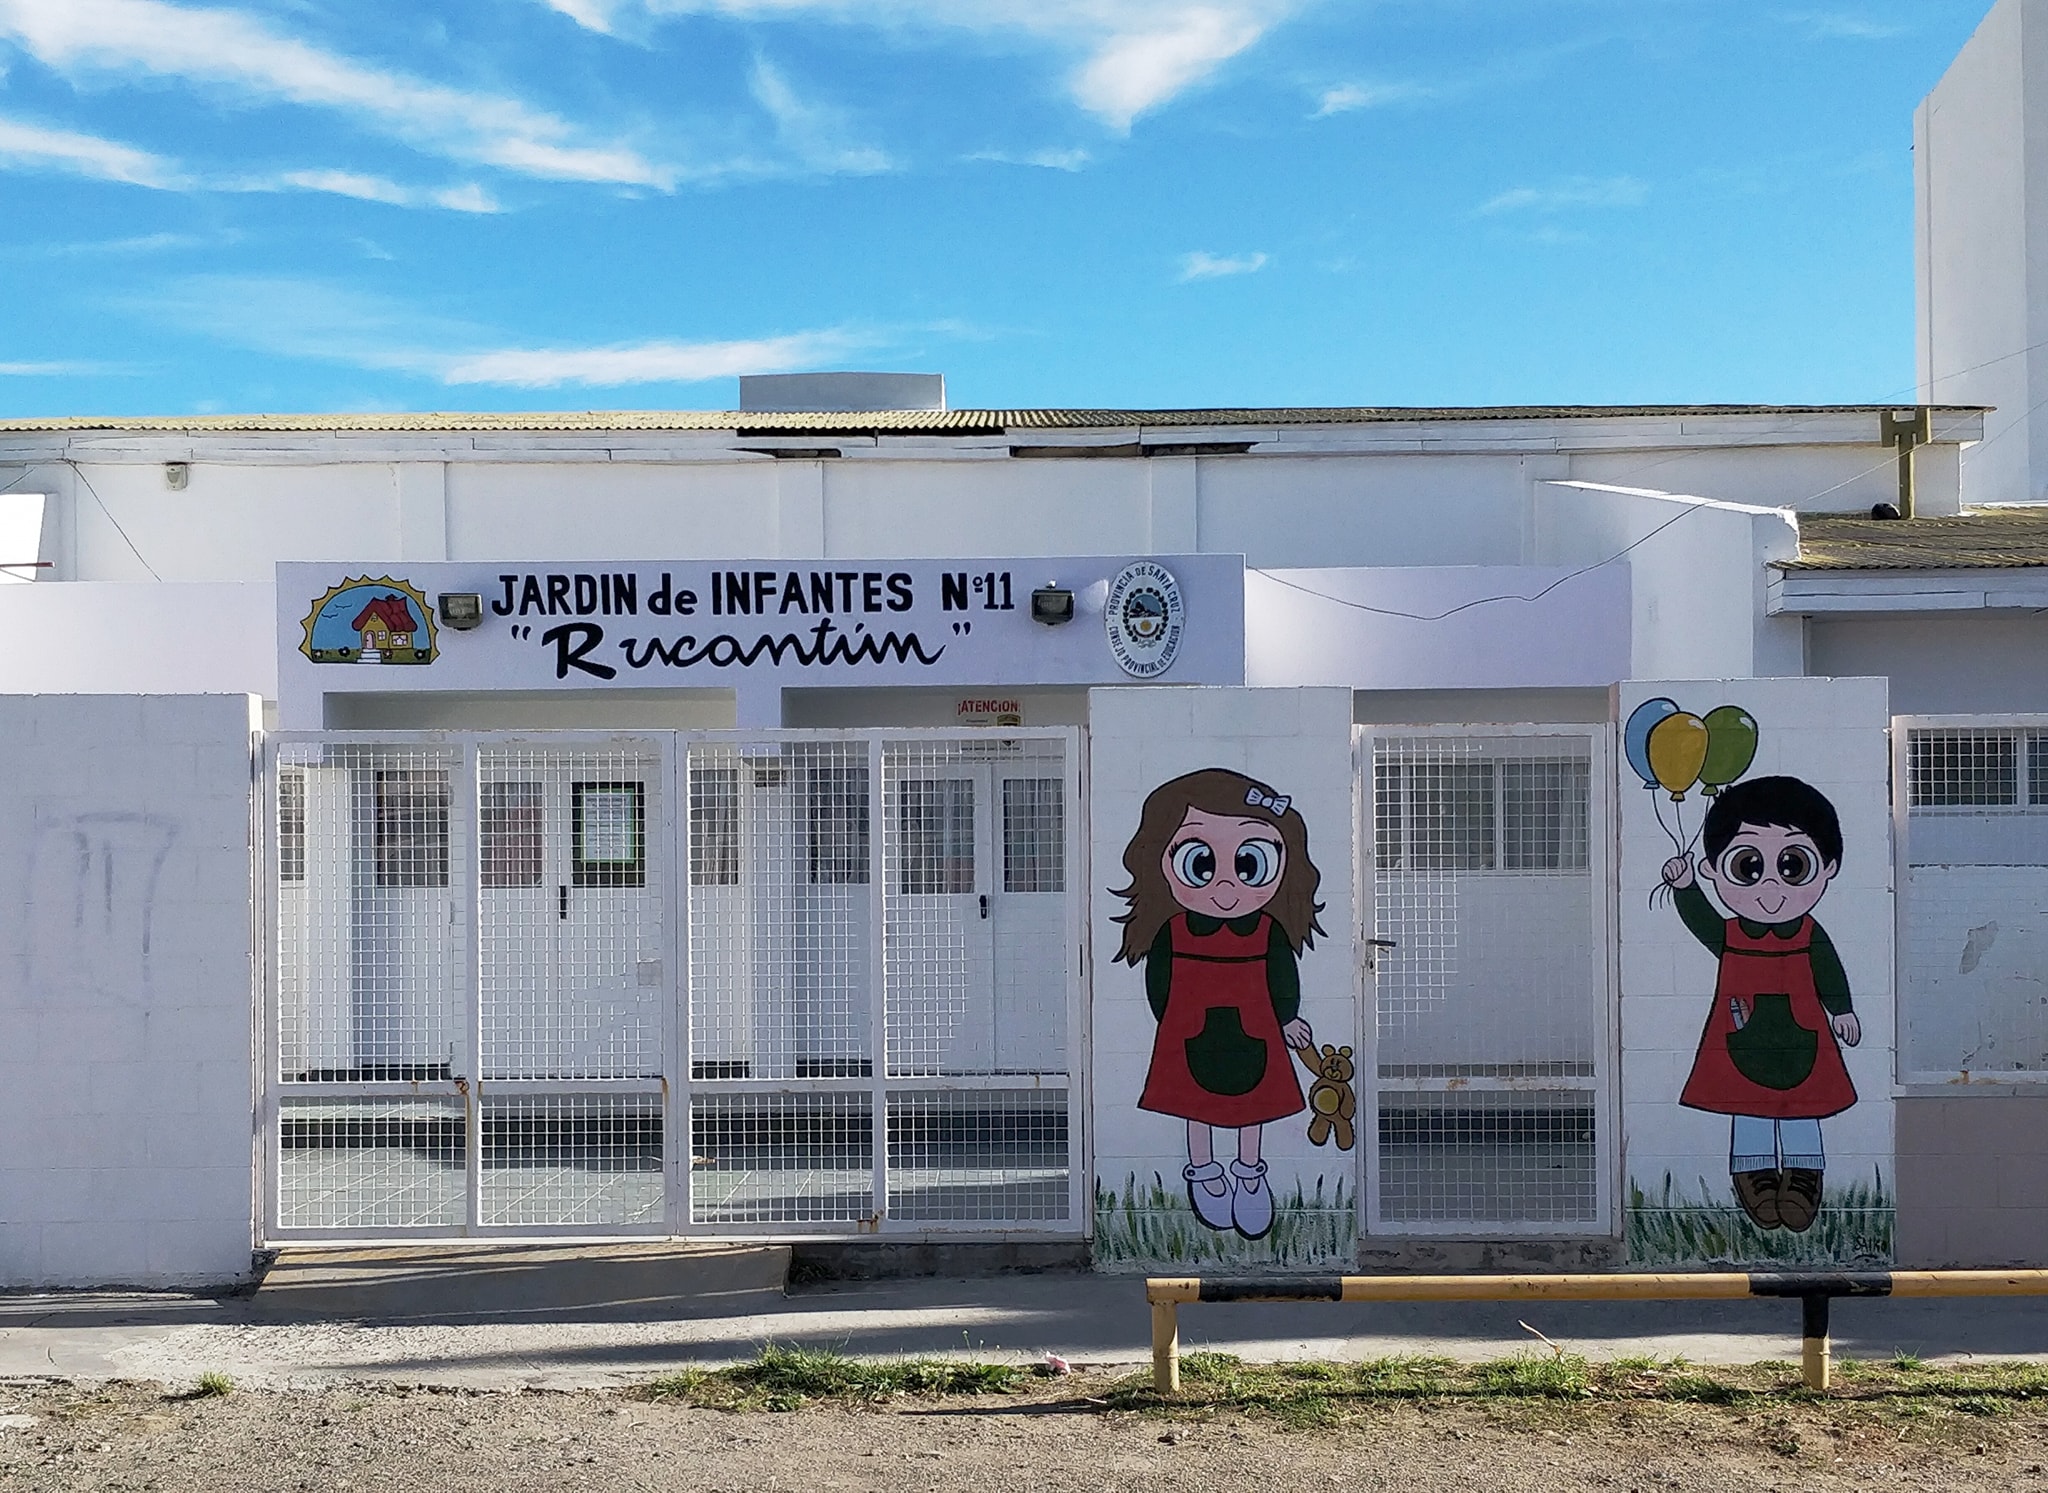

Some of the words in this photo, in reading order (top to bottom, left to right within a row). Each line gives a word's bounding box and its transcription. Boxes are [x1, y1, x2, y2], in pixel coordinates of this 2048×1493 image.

[491, 574, 638, 616] JARDIN
[647, 572, 698, 616] de
[711, 571, 914, 615] INFANTES
[1108, 571, 1135, 616] PROVINCIA
[1135, 566, 1146, 576] DE
[1147, 565, 1173, 592] SANTA
[1167, 590, 1181, 614] CRUZ
[1108, 626, 1127, 658] CONSEJO
[1121, 654, 1159, 674] PROVINCIAL
[1157, 658, 1167, 667] DE
